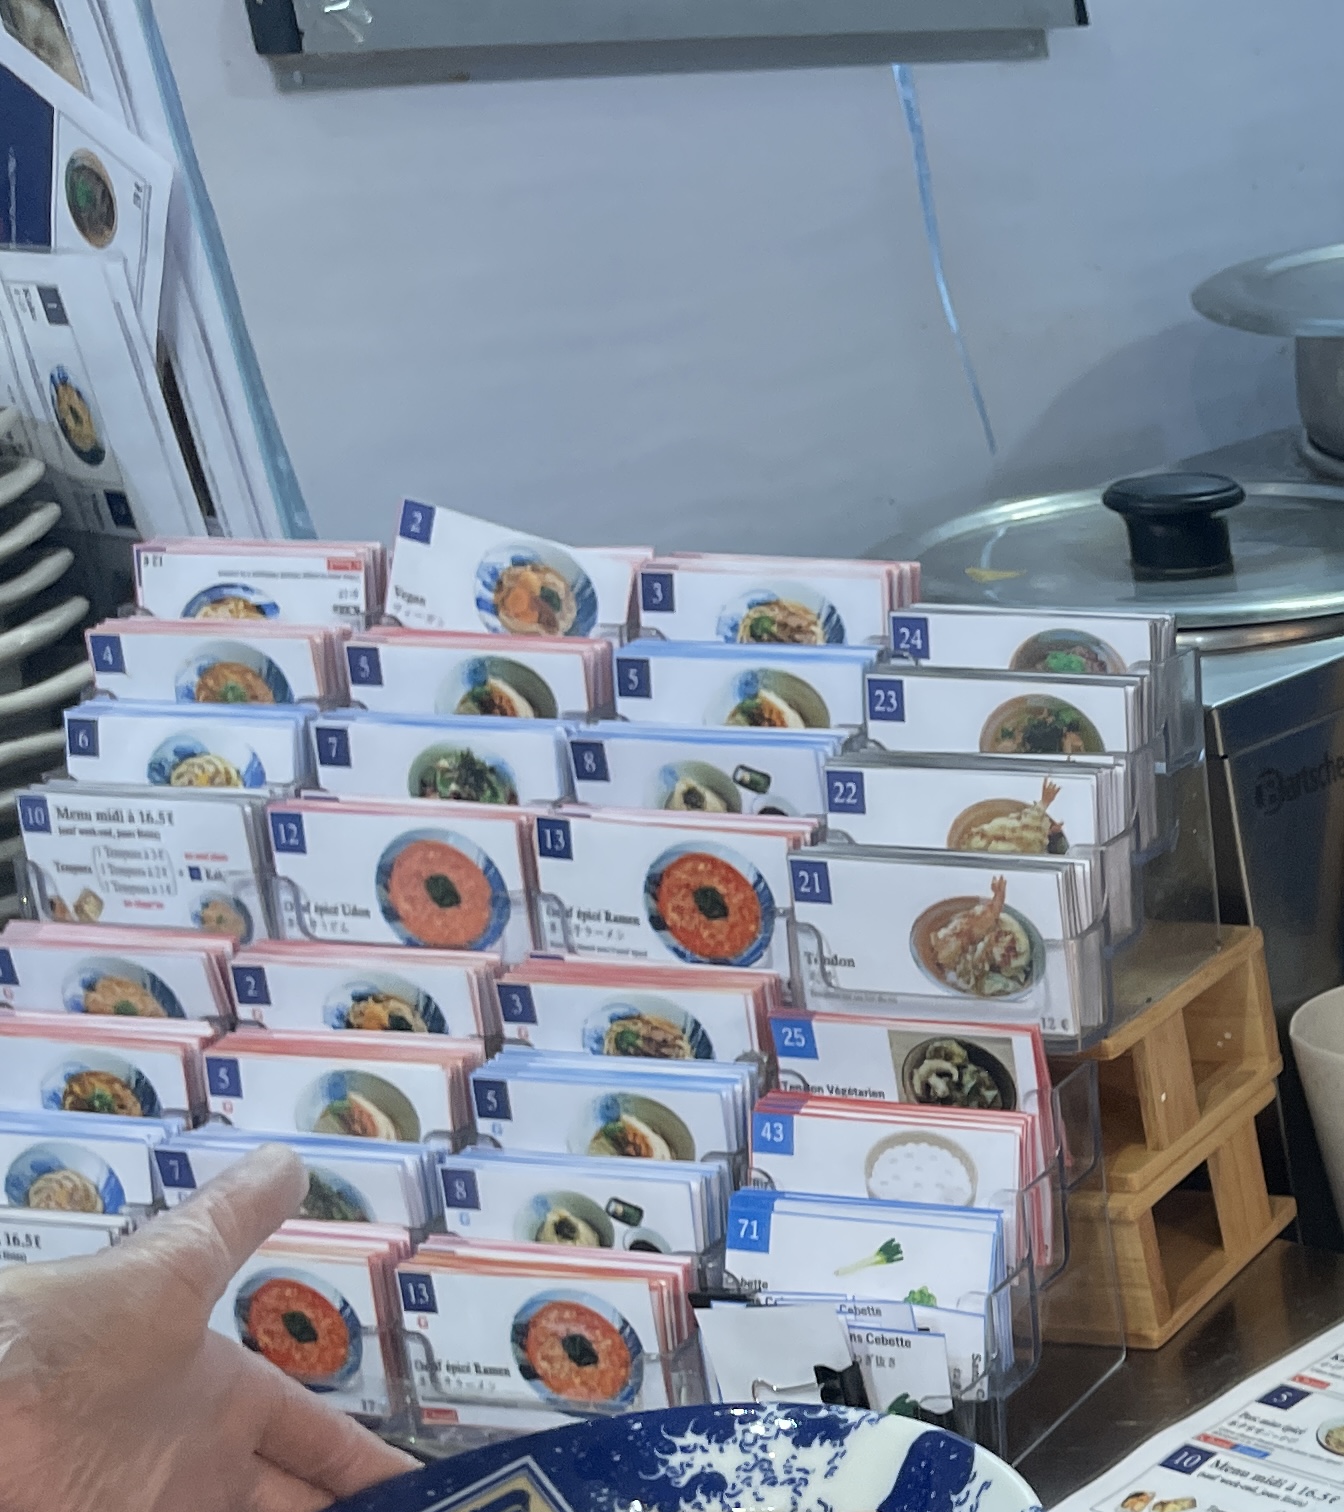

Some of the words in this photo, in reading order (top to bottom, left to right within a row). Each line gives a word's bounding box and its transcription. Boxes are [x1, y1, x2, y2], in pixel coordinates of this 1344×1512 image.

[411, 512, 423, 532] 2
[653, 582, 663, 604] 3
[899, 627, 923, 651] 24
[627, 668, 639, 690] 5
[874, 689, 897, 712] 23
[79, 733, 88, 750] 6
[328, 736, 340, 757] 7
[583, 751, 596, 772] 8
[833, 782, 857, 804] 22
[26, 806, 45, 825] 10
[95, 808, 124, 824] midi
[127, 809, 135, 824] à
[278, 823, 299, 846] 12
[544, 828, 566, 850] 13
[798, 870, 822, 893] 21
[245, 975, 260, 997] 2
[511, 995, 523, 1016] 3
[1060, 1018, 1069, 1031] €
[781, 1027, 805, 1048] 25
[487, 1090, 498, 1111] 5
[761, 1121, 784, 1143] 43
[168, 1159, 181, 1180] 7
[453, 1179, 466, 1200] 8
[738, 1218, 760, 1241] 71
[408, 1281, 429, 1304] 13
[865, 1332, 912, 1349] Cebette
[1174, 1451, 1202, 1467] 10
[1210, 1459, 1250, 1476] Menu
[1251, 1471, 1285, 1487] midi
